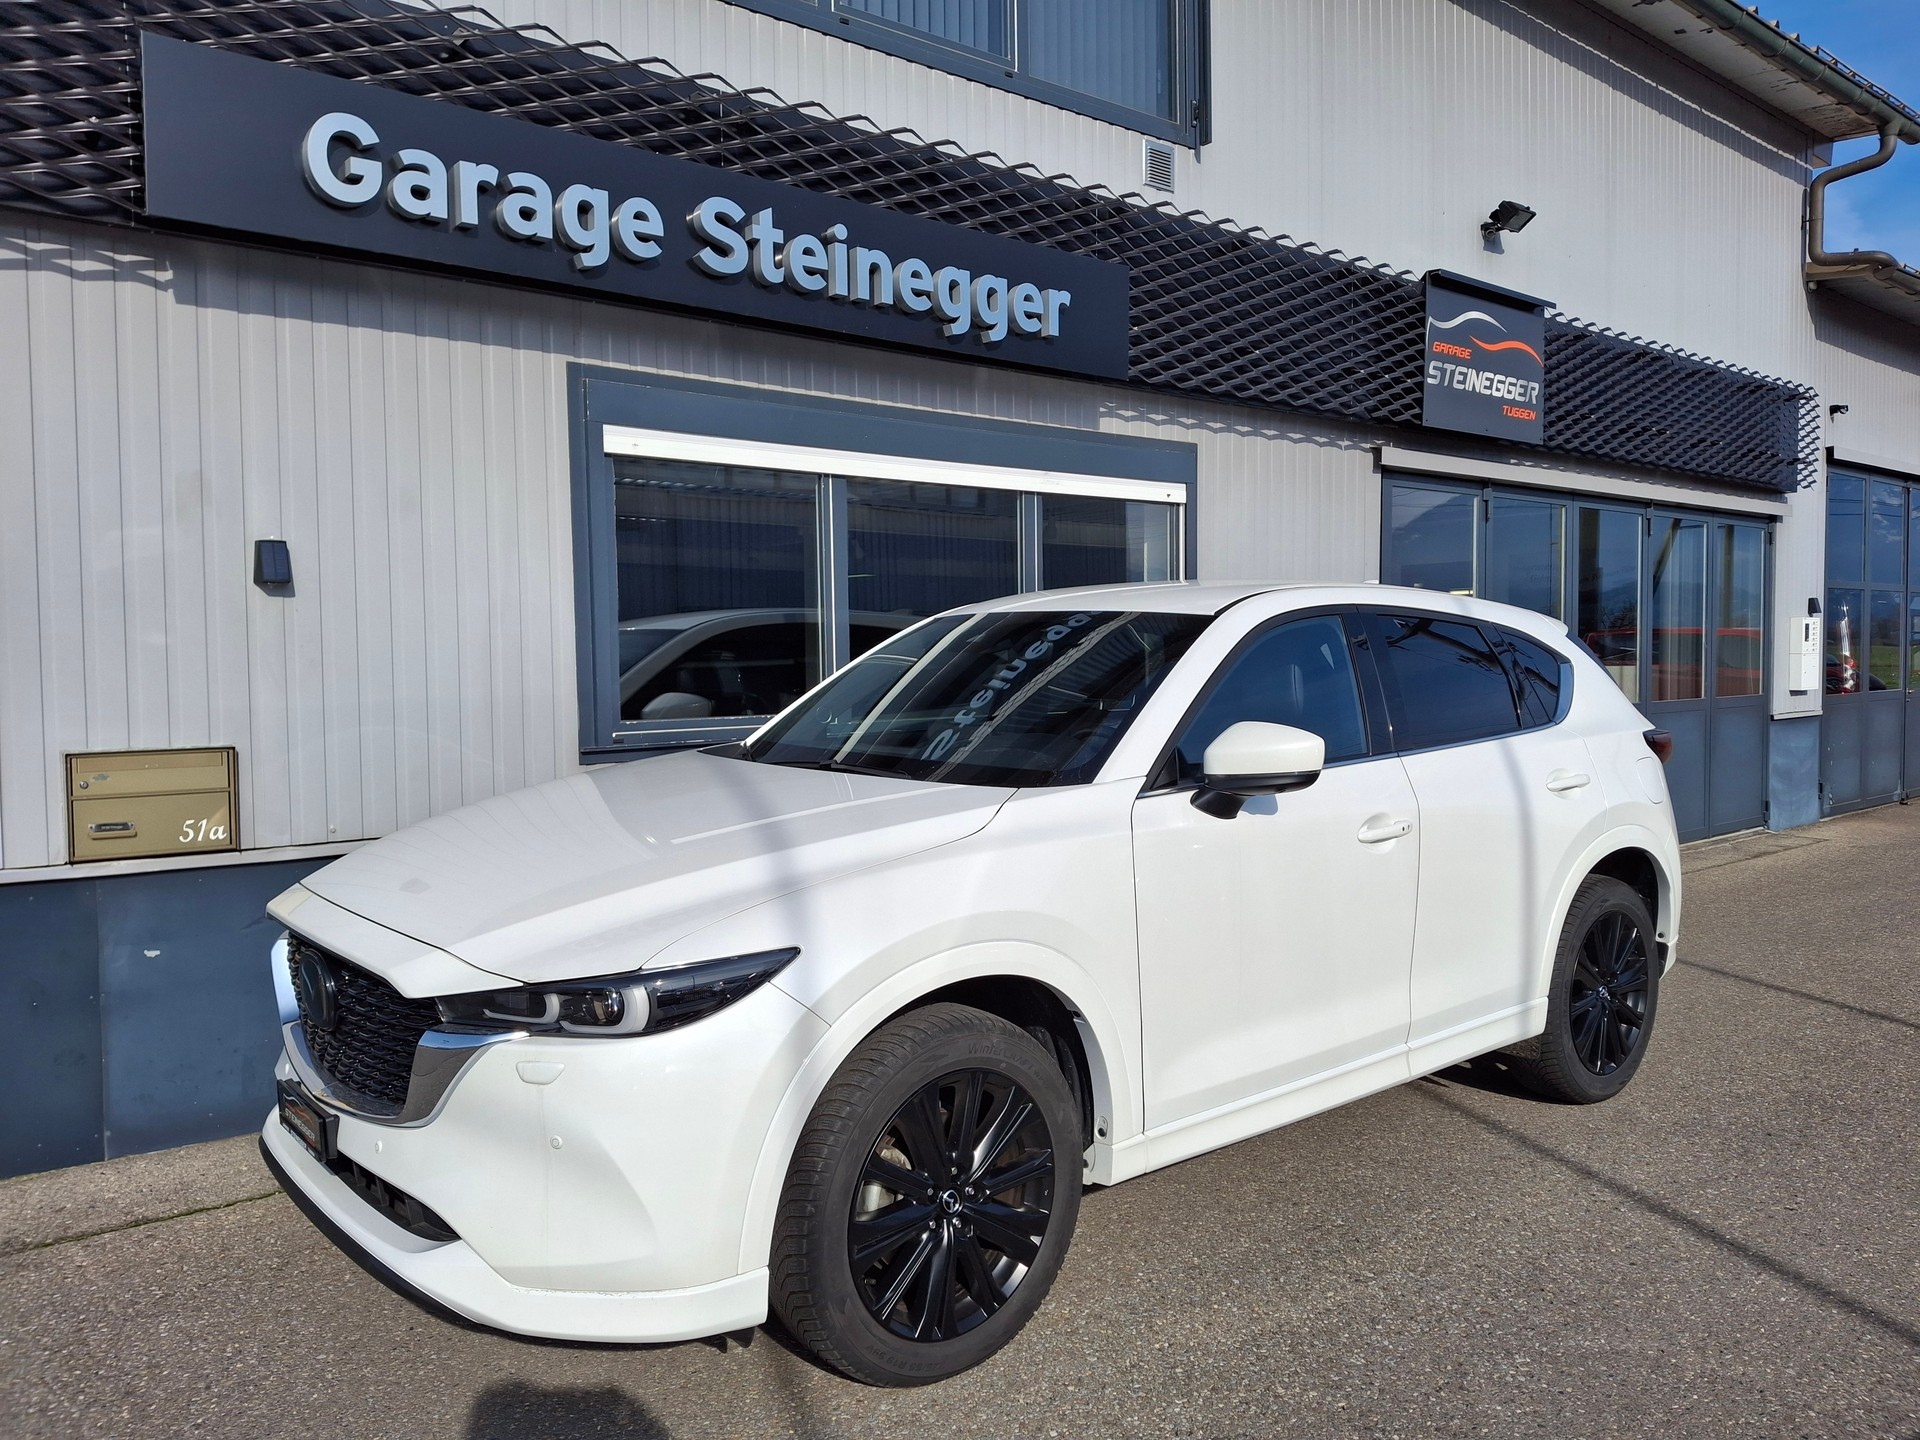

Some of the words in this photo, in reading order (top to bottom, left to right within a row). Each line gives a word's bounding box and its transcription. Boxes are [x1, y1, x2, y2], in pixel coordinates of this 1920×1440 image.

[301, 111, 665, 271] Garage
[686, 195, 1071, 343] Steinegger
[1432, 341, 1472, 359] GARAGE
[1427, 360, 1540, 405] STEINEGGER
[1502, 405, 1537, 420] TUGGEN
[179, 818, 227, 843] 51a
